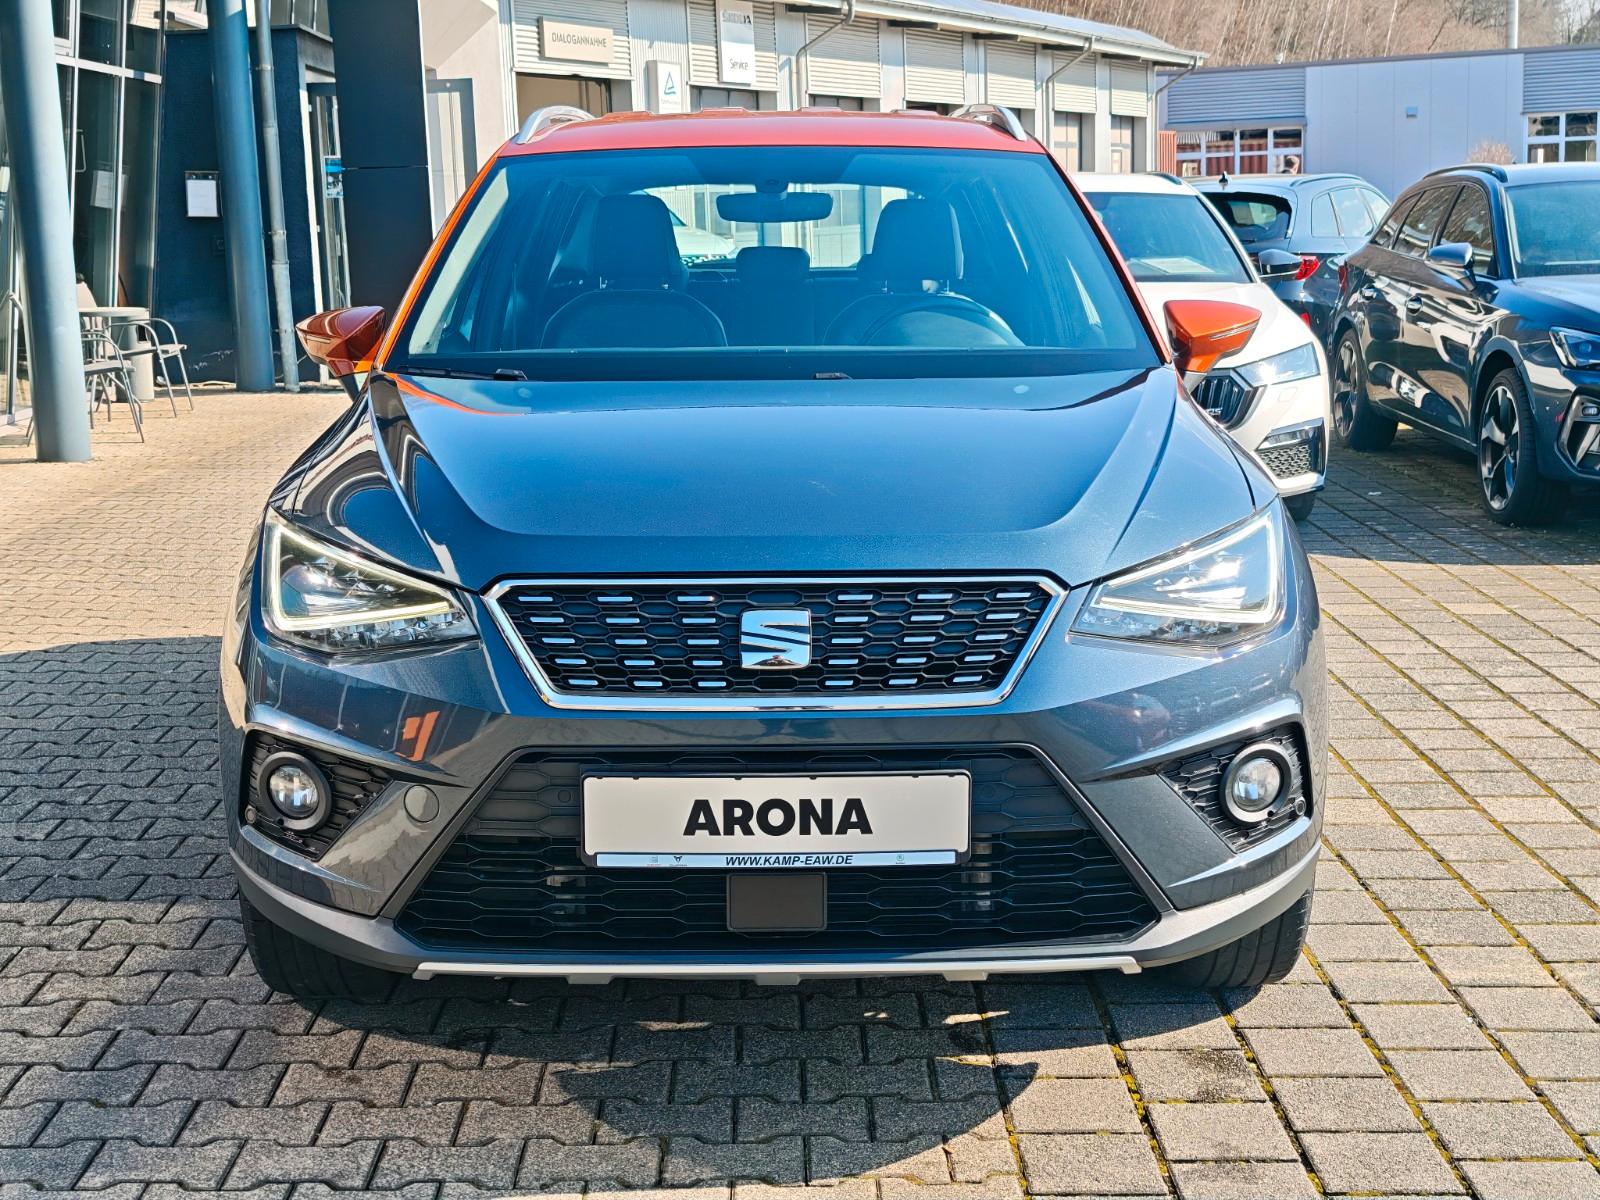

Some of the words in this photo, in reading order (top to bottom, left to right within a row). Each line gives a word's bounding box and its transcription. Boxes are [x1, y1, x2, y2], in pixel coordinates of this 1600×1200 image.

[551, 32, 607, 48] DIALOGANNAHME
[729, 58, 749, 71] Service
[683, 798, 873, 837] ARONA
[726, 855, 853, 867] WWW.KAMP-EAW.DE
